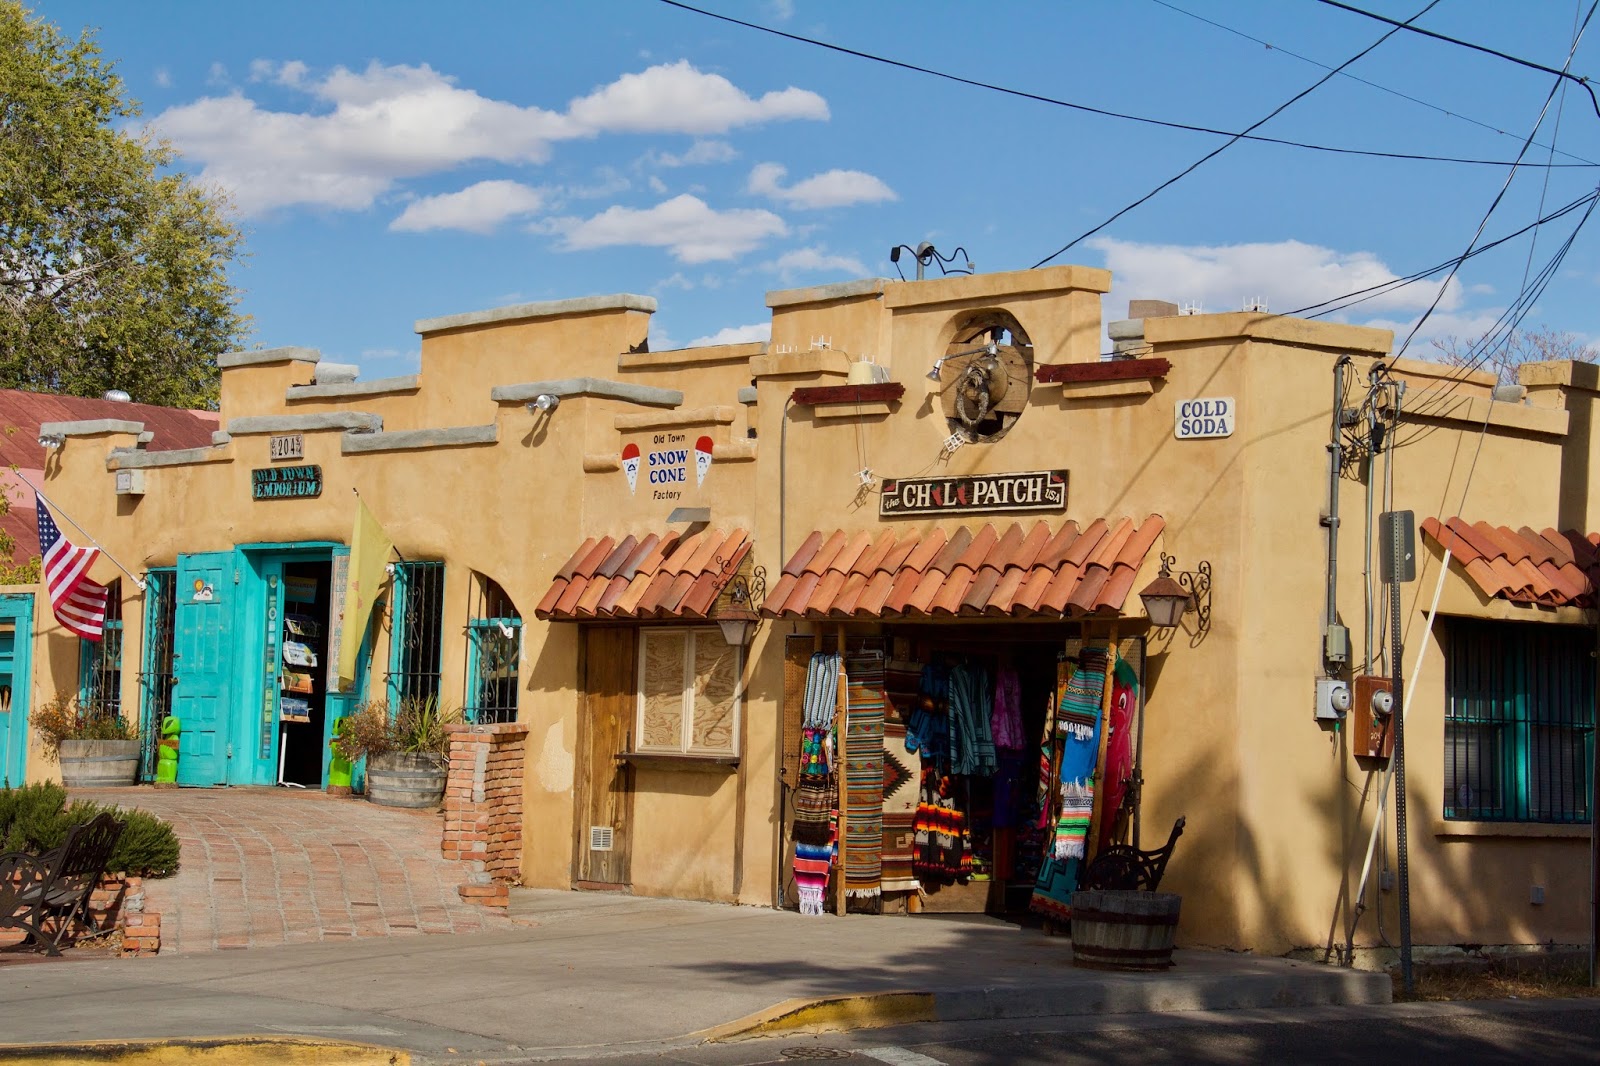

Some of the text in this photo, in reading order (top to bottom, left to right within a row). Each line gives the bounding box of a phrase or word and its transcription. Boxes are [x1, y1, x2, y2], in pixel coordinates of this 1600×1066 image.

[1181, 400, 1227, 418] COLD
[1181, 418, 1228, 435] SODA
[278, 438, 295, 456] 204
[653, 433, 686, 444] Old Town
[648, 449, 688, 466] SNOW
[256, 465, 315, 482] OLD TOWN
[649, 467, 686, 484] CONE
[256, 480, 317, 498] EMPORIUM
[653, 489, 682, 500] Factory
[884, 497, 900, 510] the
[971, 477, 1044, 505] PATCH
[1044, 488, 1061, 503] USA
